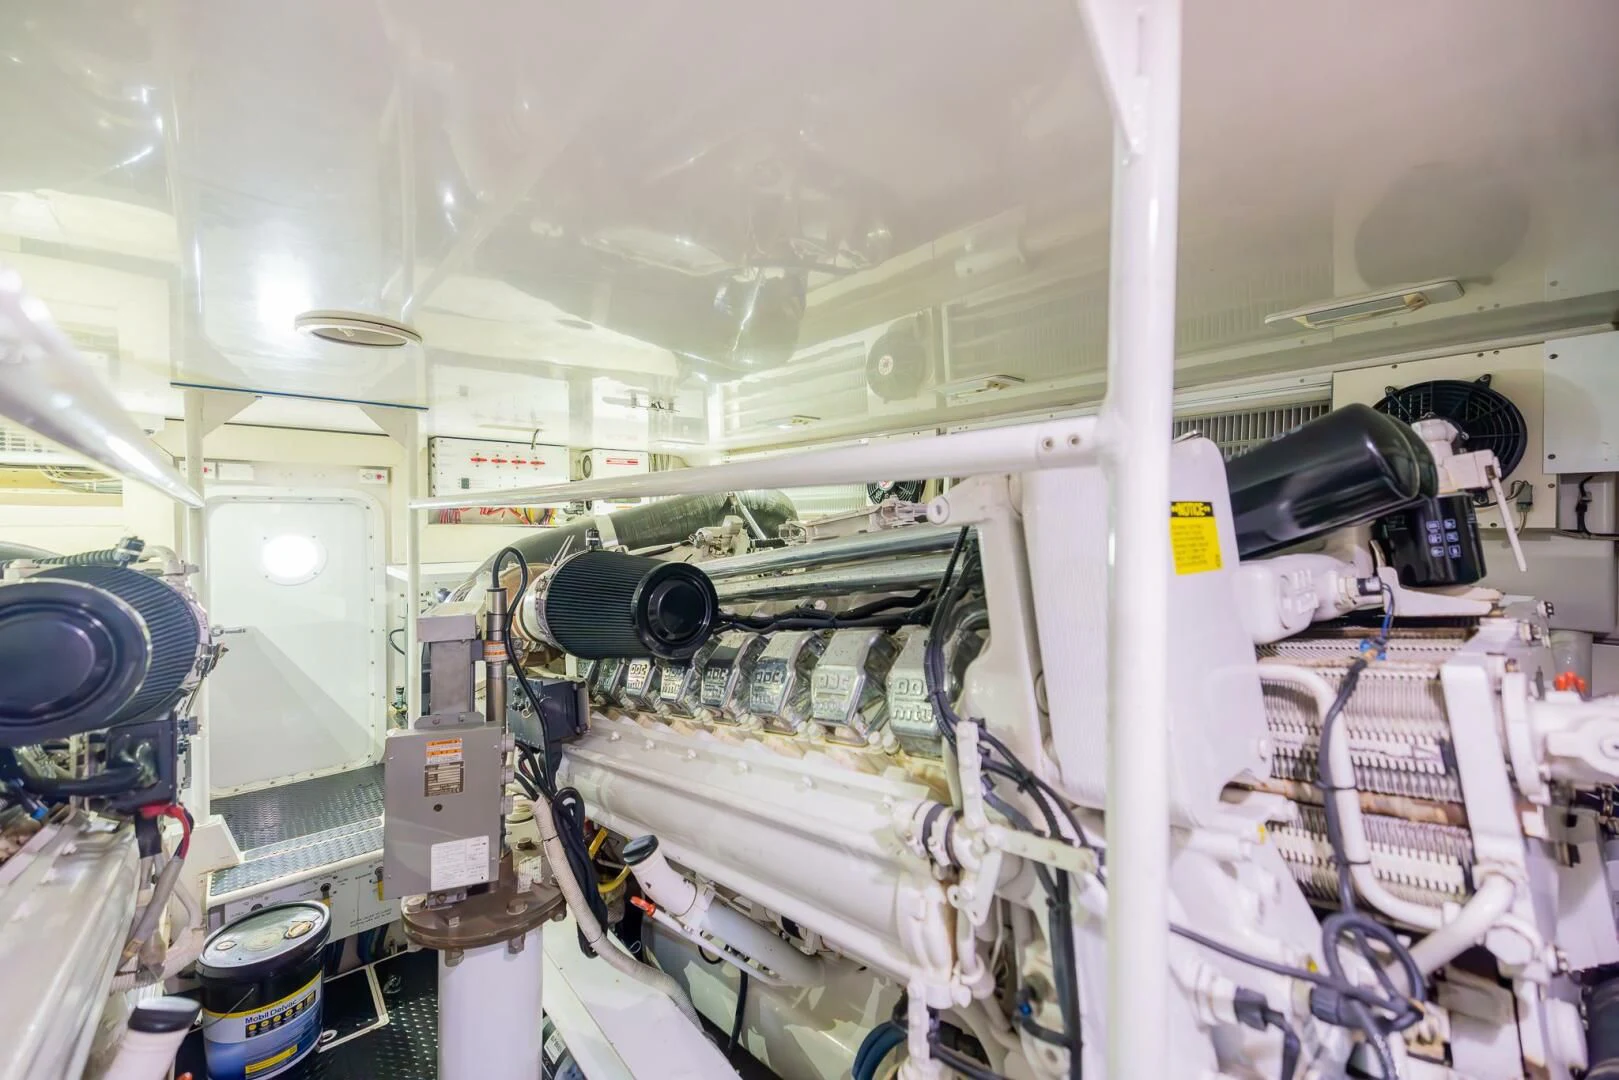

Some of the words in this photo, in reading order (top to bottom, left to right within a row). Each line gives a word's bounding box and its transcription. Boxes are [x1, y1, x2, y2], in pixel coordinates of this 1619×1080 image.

[895, 678, 925, 696] DD
[892, 704, 934, 724] mtu
[245, 1012, 269, 1024] Mobil
